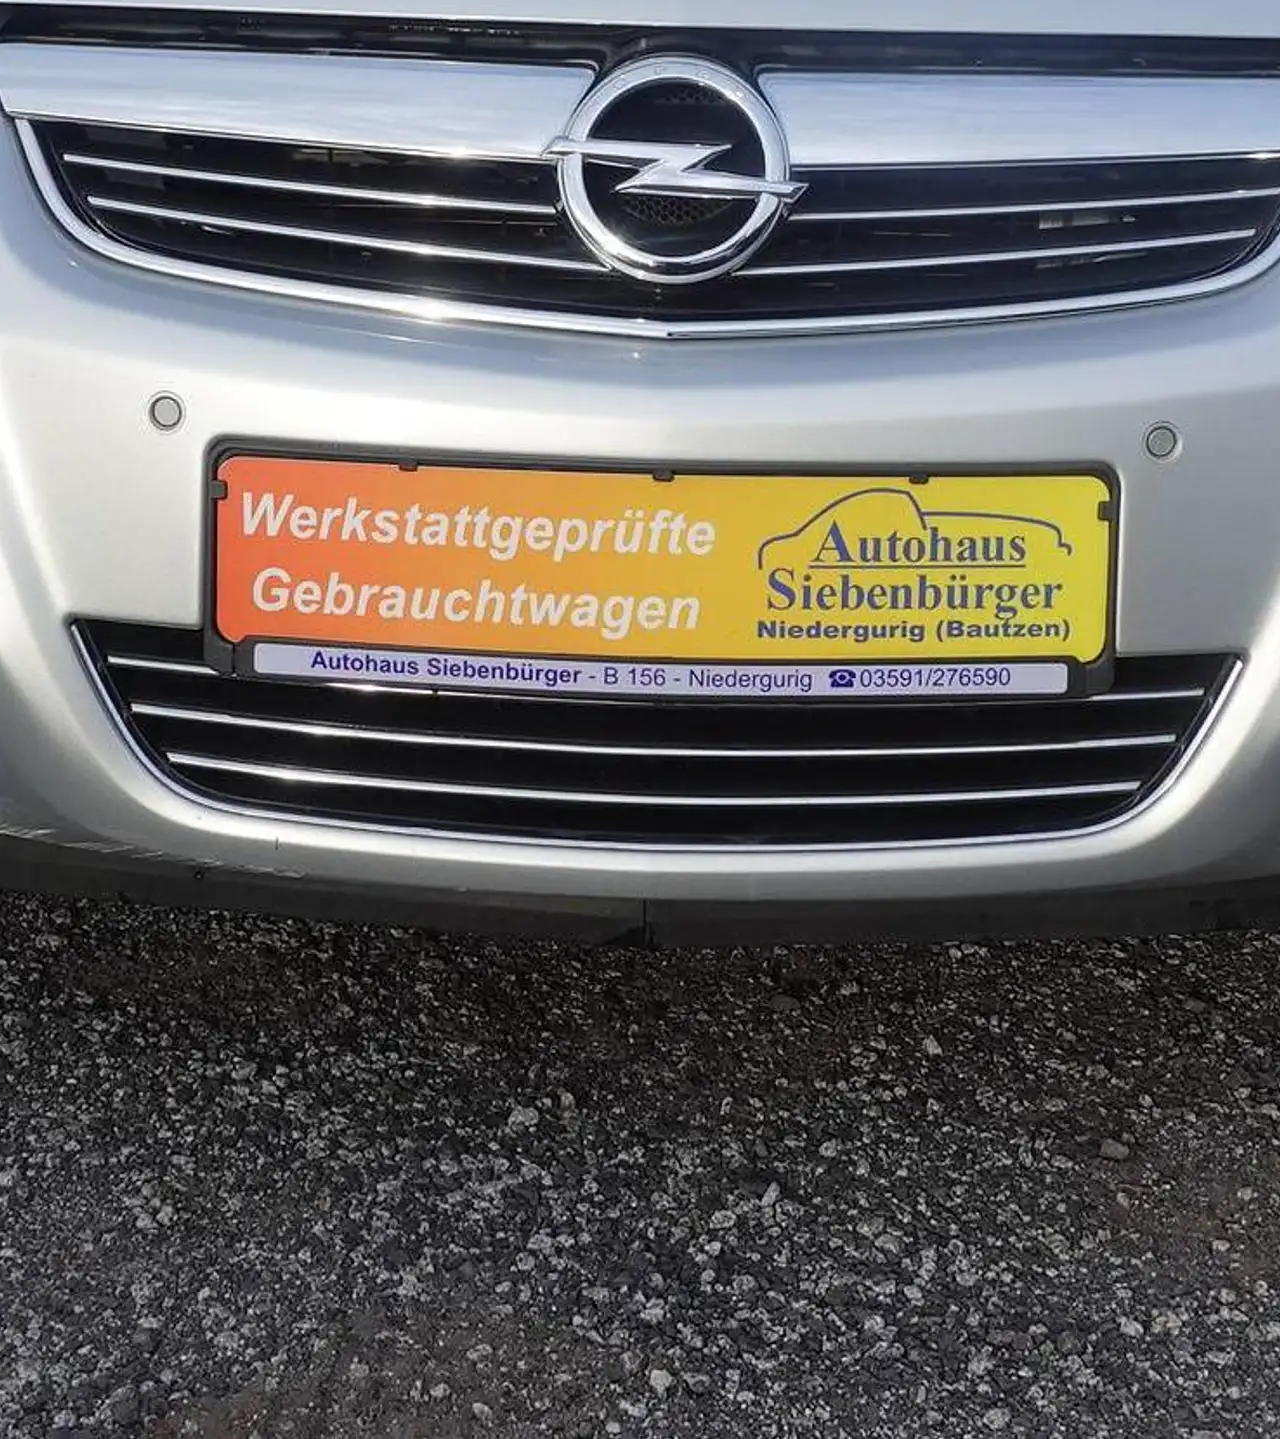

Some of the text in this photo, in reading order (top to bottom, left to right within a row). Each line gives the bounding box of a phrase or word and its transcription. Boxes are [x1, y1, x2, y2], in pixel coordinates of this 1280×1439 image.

[242, 491, 716, 560] Werkstattgeprüfte
[810, 519, 1026, 563] Autohaus
[252, 567, 701, 640] Gebrauchtwagen
[767, 567, 1063, 620] Siebenbürger
[757, 619, 1071, 642] Niedergurig (Bautzen)
[310, 651, 419, 676] Autohaus
[427, 657, 582, 687] Siebenbürger
[603, 667, 619, 685] B
[628, 668, 665, 686] 156
[689, 668, 813, 692] Niedergurig
[860, 668, 1010, 688] 03591/276590
